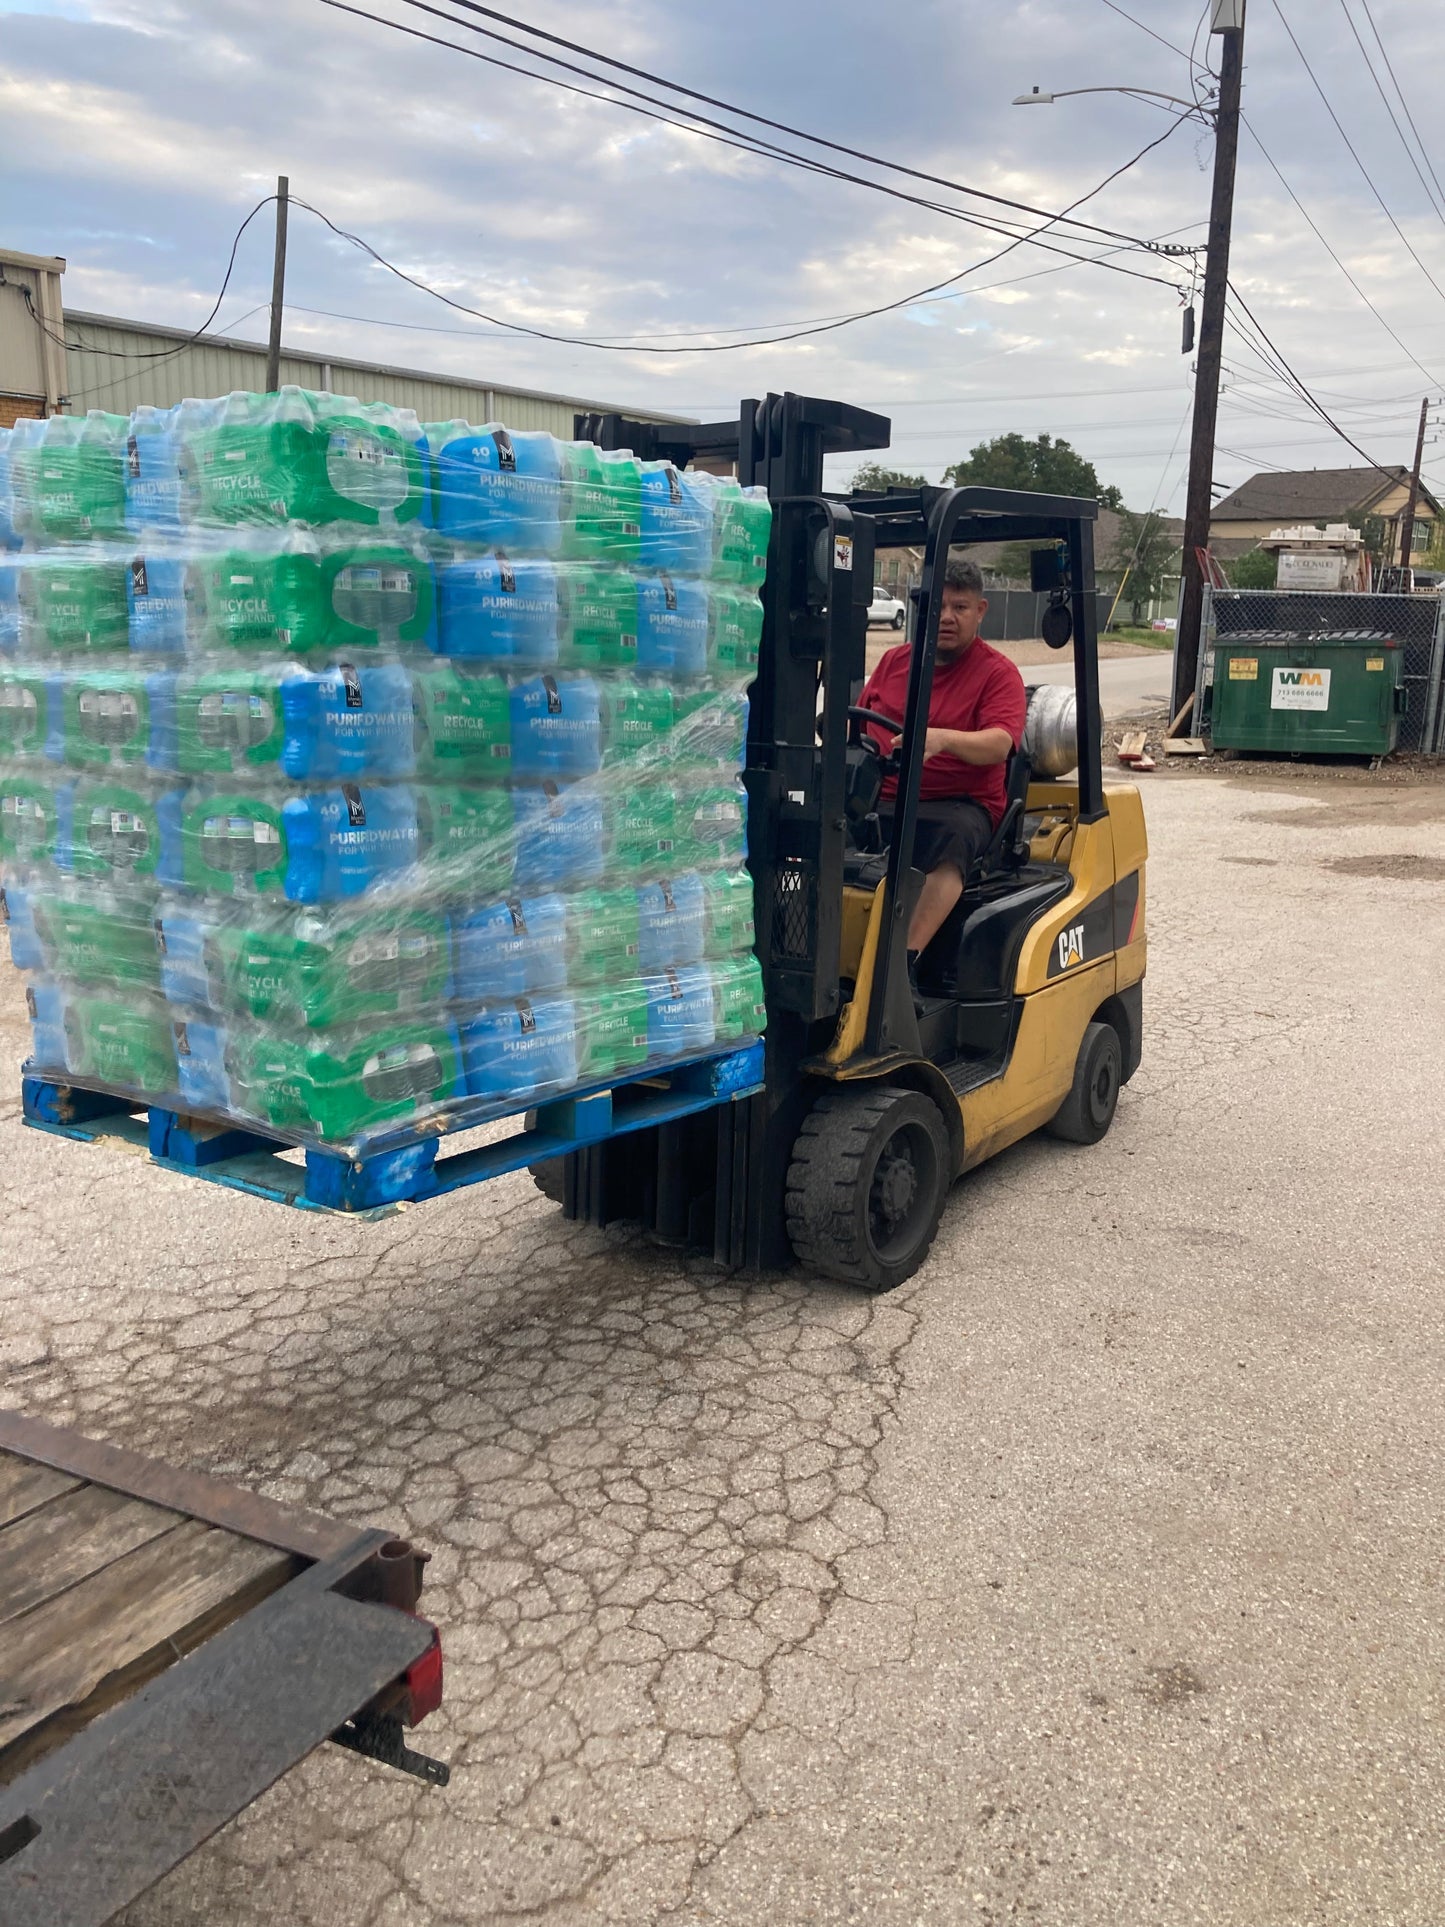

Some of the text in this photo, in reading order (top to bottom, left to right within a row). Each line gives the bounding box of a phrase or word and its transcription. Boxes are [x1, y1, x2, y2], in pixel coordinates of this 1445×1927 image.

[472, 446, 490, 457] 40
[474, 568, 492, 579] 40
[1279, 672, 1323, 686] WM
[318, 682, 337, 694] 40
[326, 711, 375, 727] PURIFD
[320, 803, 339, 816] 40
[625, 817, 654, 829] RECLE
[329, 829, 378, 845] PURIFD
[1058, 924, 1084, 969] CAT
[503, 1035, 547, 1052] PURIFED
